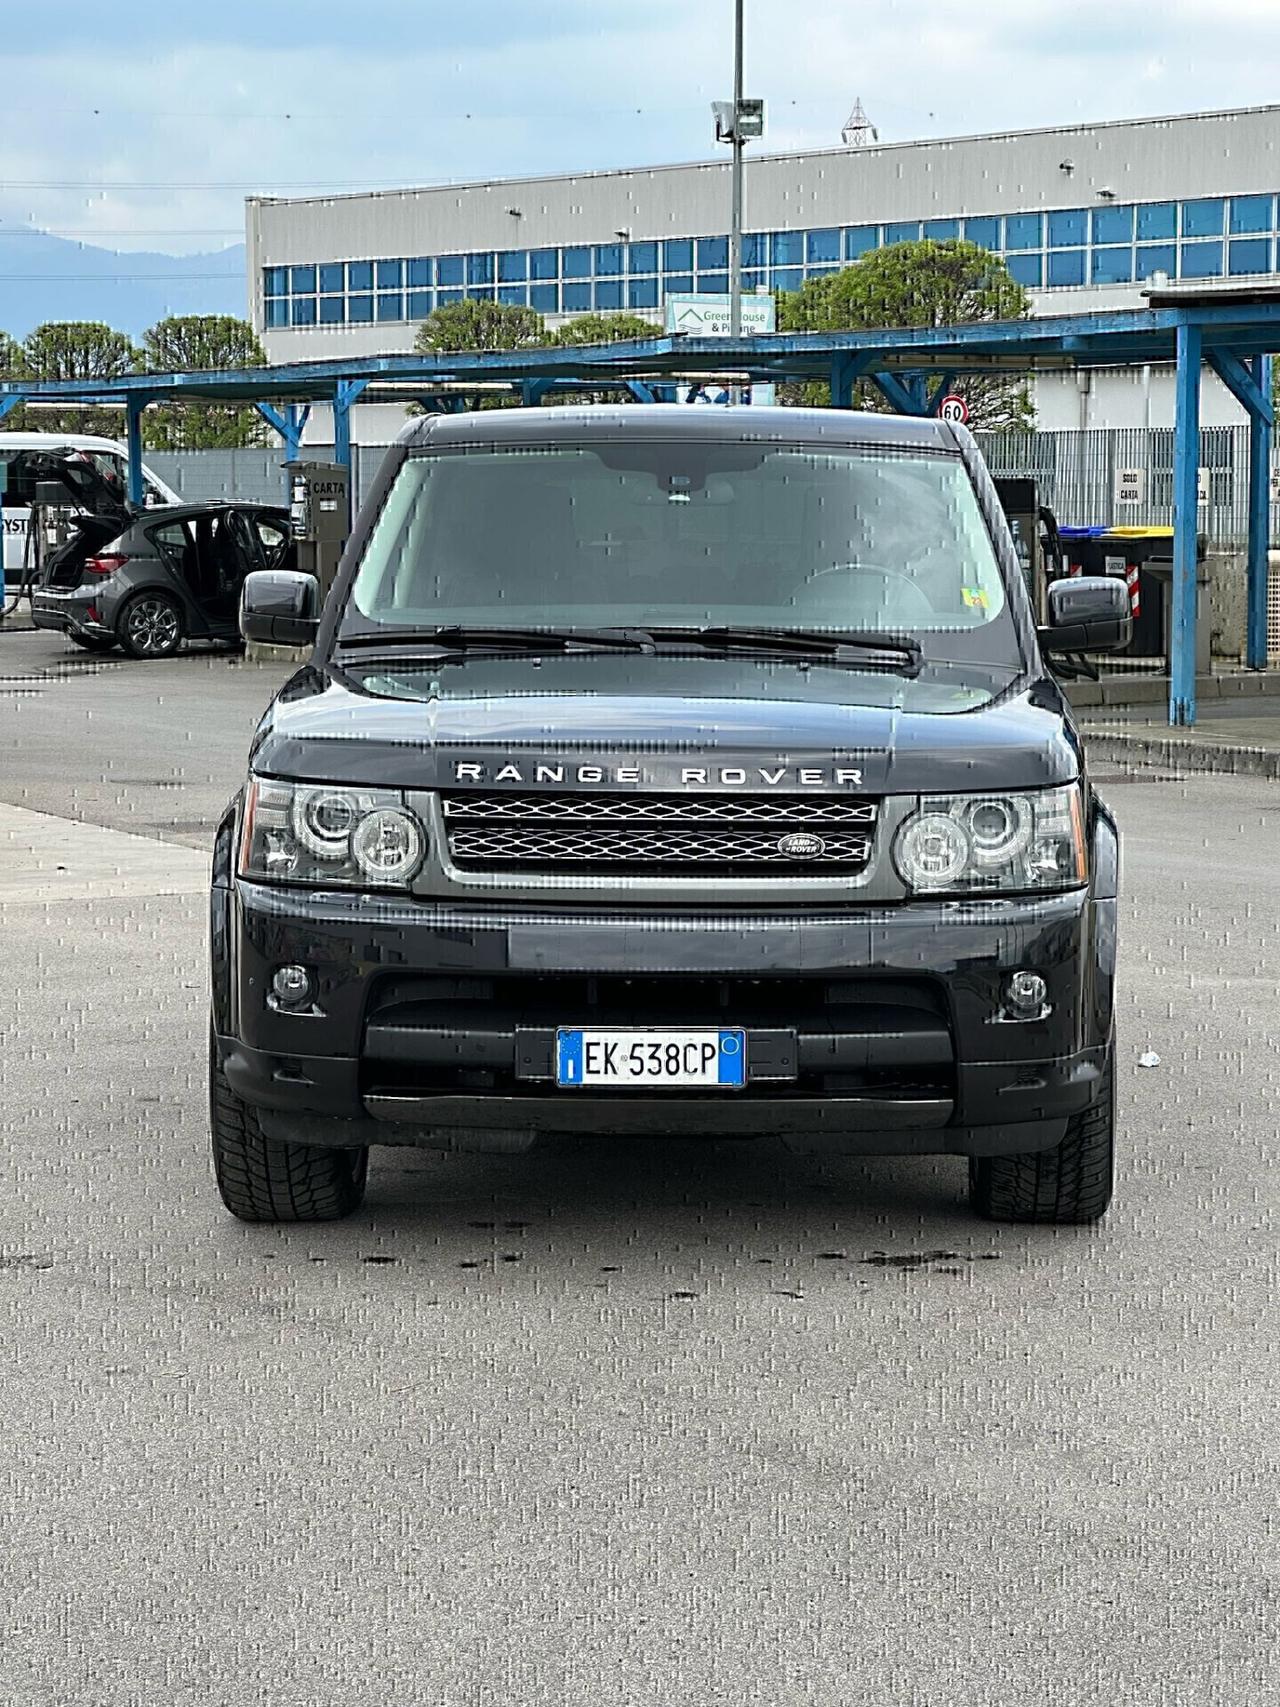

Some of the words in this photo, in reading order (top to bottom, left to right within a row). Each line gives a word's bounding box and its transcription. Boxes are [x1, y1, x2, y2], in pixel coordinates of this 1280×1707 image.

[740, 312, 766, 322] ouse
[711, 322, 720, 333] &
[721, 323, 756, 333] Piine
[944, 405, 962, 420] 60
[1122, 474, 1138, 483] SOLO
[313, 481, 346, 496] CARTA
[456, 763, 640, 783] RANGE
[681, 768, 863, 785] ROVER
[790, 845, 817, 853] ROVER
[585, 1042, 618, 1075] EK
[629, 1043, 716, 1076] 538CP
